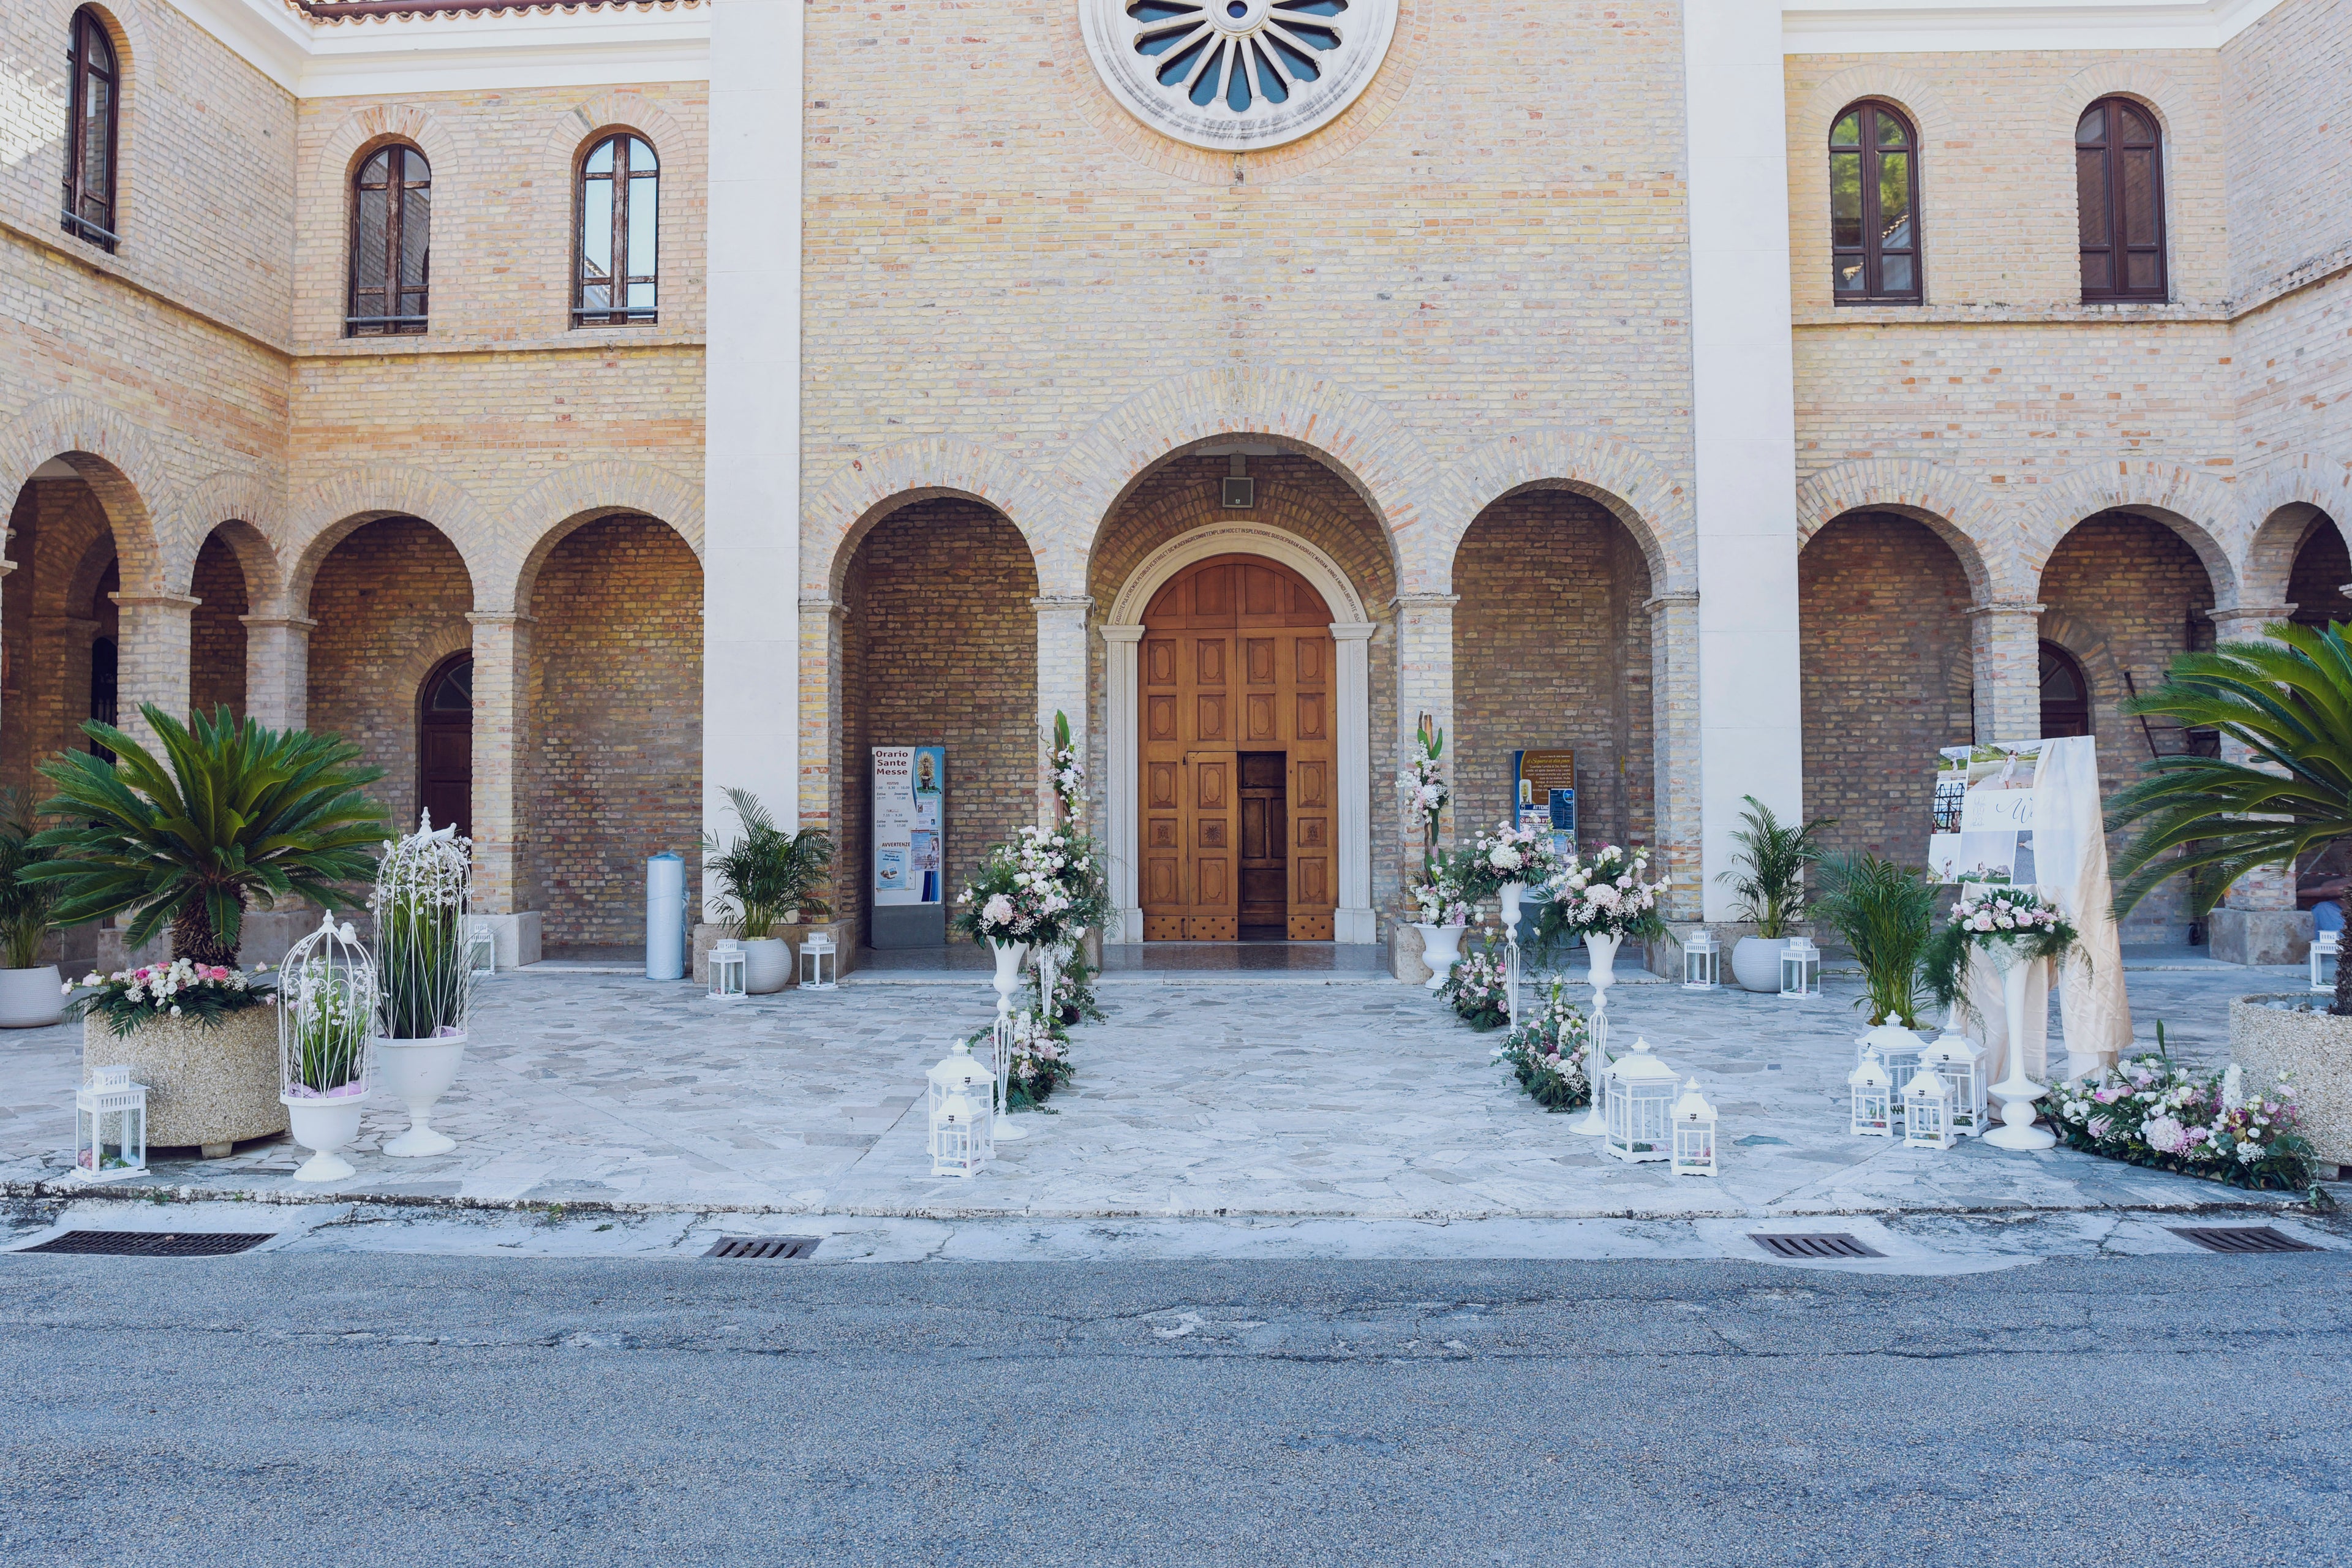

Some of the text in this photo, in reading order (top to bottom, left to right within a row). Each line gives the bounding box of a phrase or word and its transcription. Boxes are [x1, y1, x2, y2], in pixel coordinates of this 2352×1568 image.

[1115, 605, 1125, 625] EXCUTITE
[1121, 585, 1136, 605] PULVEREM
[1136, 566, 1151, 581] PEDIBUS
[1298, 545, 1316, 559] ADORATE
[1314, 556, 1328, 568] MARIAM
[1327, 568, 1337, 579] ANNO
[1344, 590, 1357, 612] LIBERTATE
